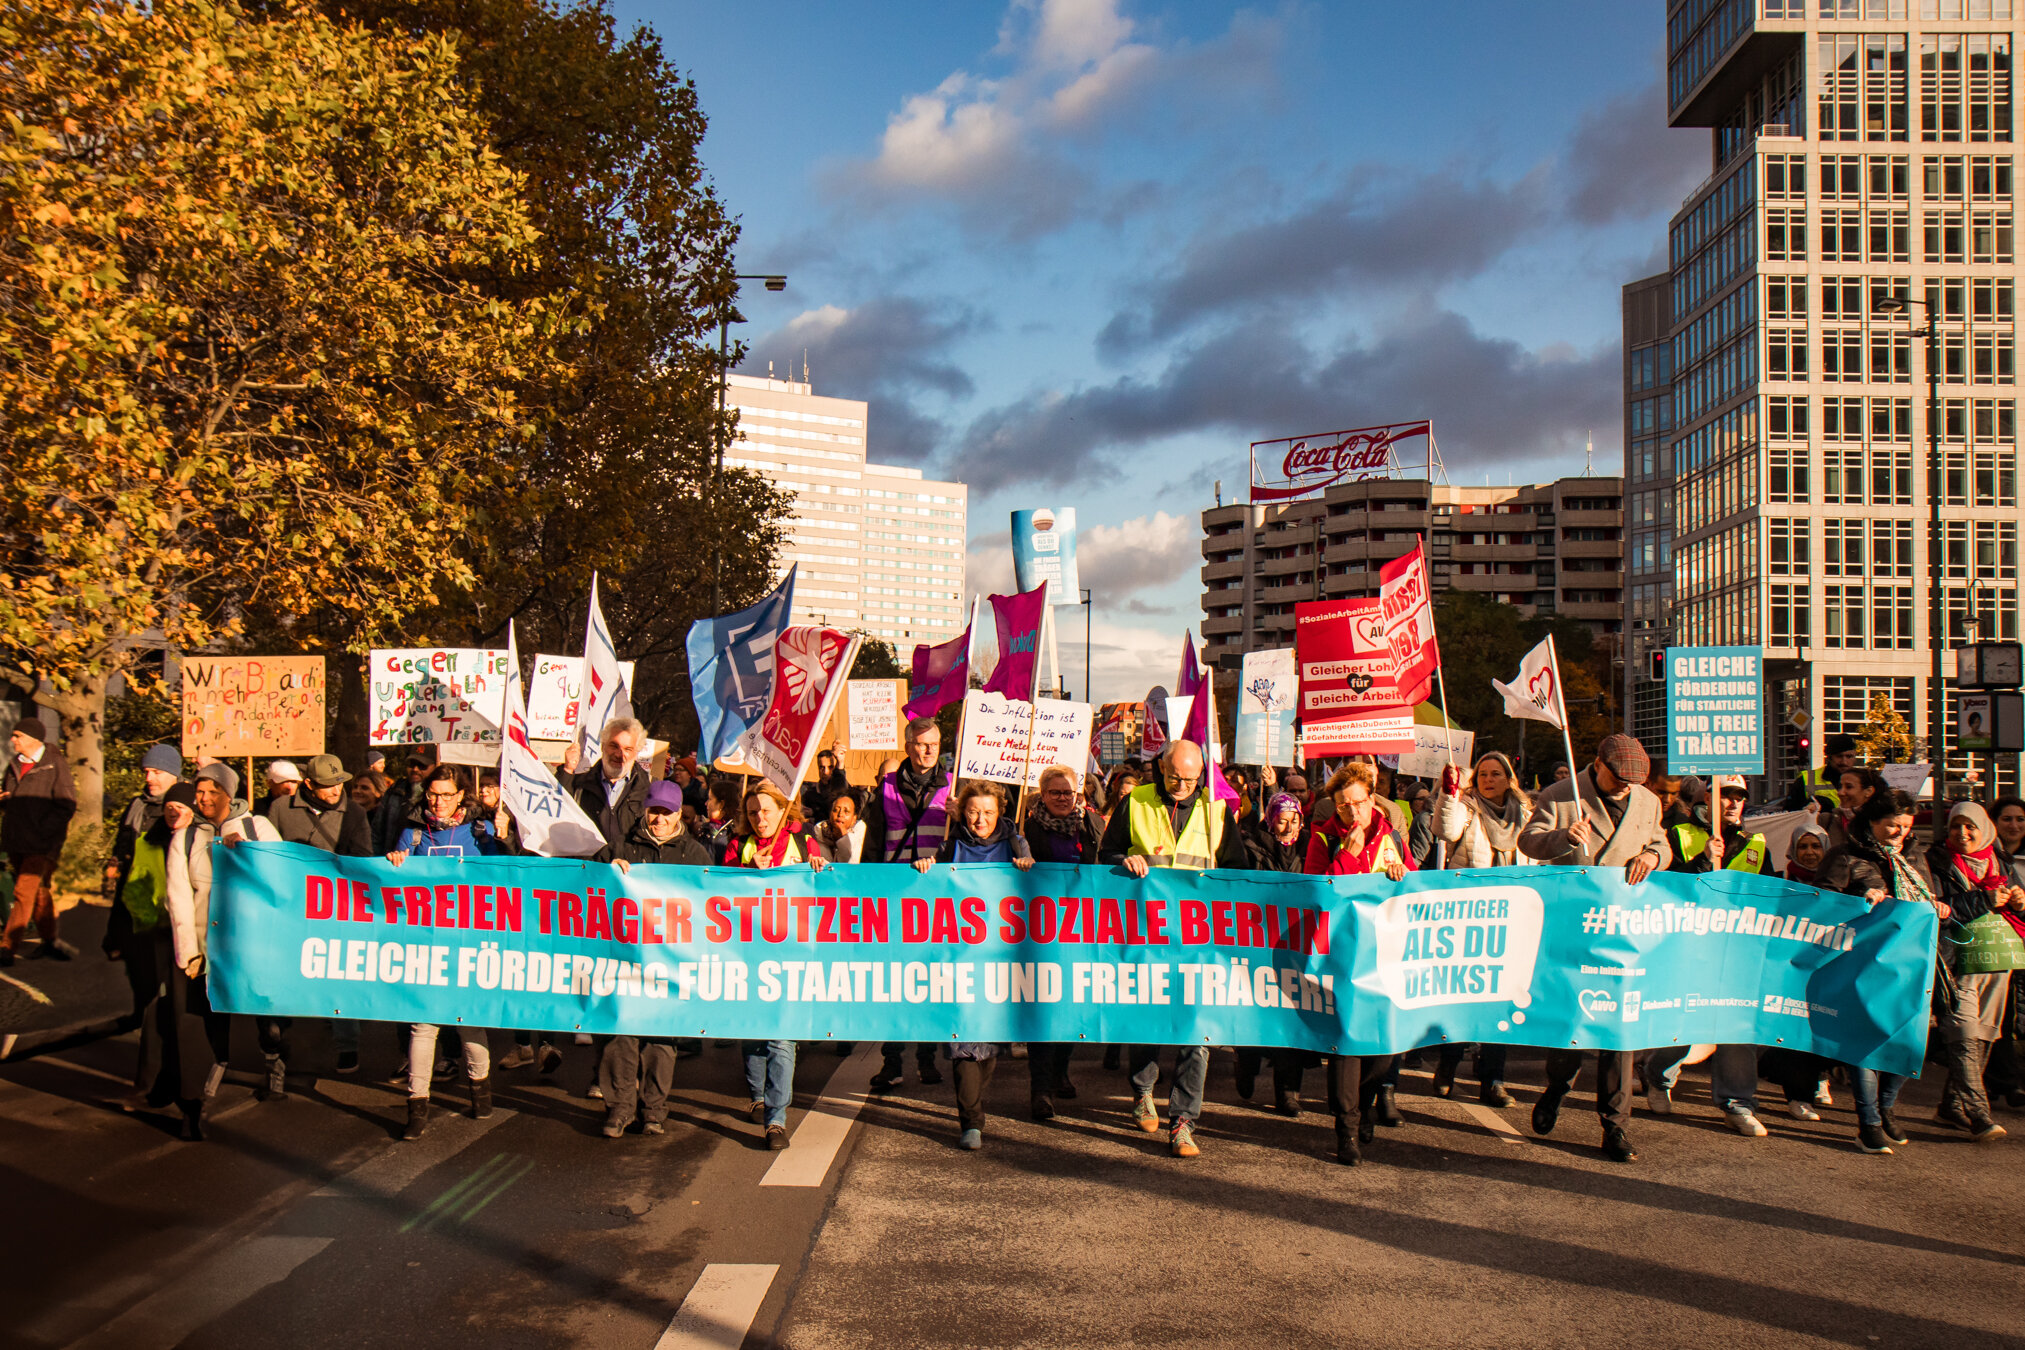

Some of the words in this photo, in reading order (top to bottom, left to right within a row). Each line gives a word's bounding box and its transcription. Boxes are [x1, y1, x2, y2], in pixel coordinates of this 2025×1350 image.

[1282, 430, 1391, 477] Coca-Cola
[186, 663, 232, 688] Wir
[386, 652, 458, 685] Gegen
[472, 651, 508, 675] die
[1310, 664, 1364, 676] Gleicher
[1674, 656, 1756, 678] GLEICHE
[1350, 678, 1370, 688] für
[1675, 680, 1756, 696] FÖRDERUNG
[207, 684, 251, 704] mehr
[1312, 692, 1358, 706] gleiche
[1362, 690, 1401, 701] Arbeit
[450, 698, 475, 712] der
[979, 703, 996, 714] Die
[1060, 712, 1075, 723] ist
[1675, 699, 1694, 711] FÜR
[1696, 700, 1756, 711] STAATLICHE
[372, 720, 433, 743] freien
[1307, 718, 1401, 732] #WichtigerAlsDuDenkst
[1676, 716, 1709, 732] UND
[1713, 714, 1757, 732] FREIE
[976, 735, 1002, 748] Teure
[1041, 730, 1055, 738] wie
[1306, 732, 1410, 741] #GefährdeterAlsDuDenkst
[1676, 732, 1757, 756] TRÄGER!
[966, 760, 978, 774] Wo
[305, 874, 374, 923] DIE
[380, 884, 523, 932] FREIEN
[532, 887, 693, 944] TRÄGER
[704, 888, 890, 944] STÜTZEN
[901, 896, 987, 945] DAS
[999, 896, 1170, 946] SOZIALE
[1179, 899, 1331, 956] BERLIN
[1406, 899, 1510, 923] WICHTIGER
[1582, 902, 1857, 952] #FreieTrägerAmLimit
[1401, 926, 1456, 962] ALS
[1463, 924, 1508, 958] DU
[300, 937, 450, 987] GLEICHE
[457, 942, 670, 999] FÖRDERUNG
[678, 953, 749, 1002] FÜR
[758, 960, 976, 1004] STAATLICHE
[984, 962, 1062, 1004] UND
[1072, 962, 1170, 1006] FREIE
[1178, 956, 1336, 1016] TRÄGER!
[1402, 964, 1504, 1000] DENKST
[1590, 1000, 1618, 1012] AWO
